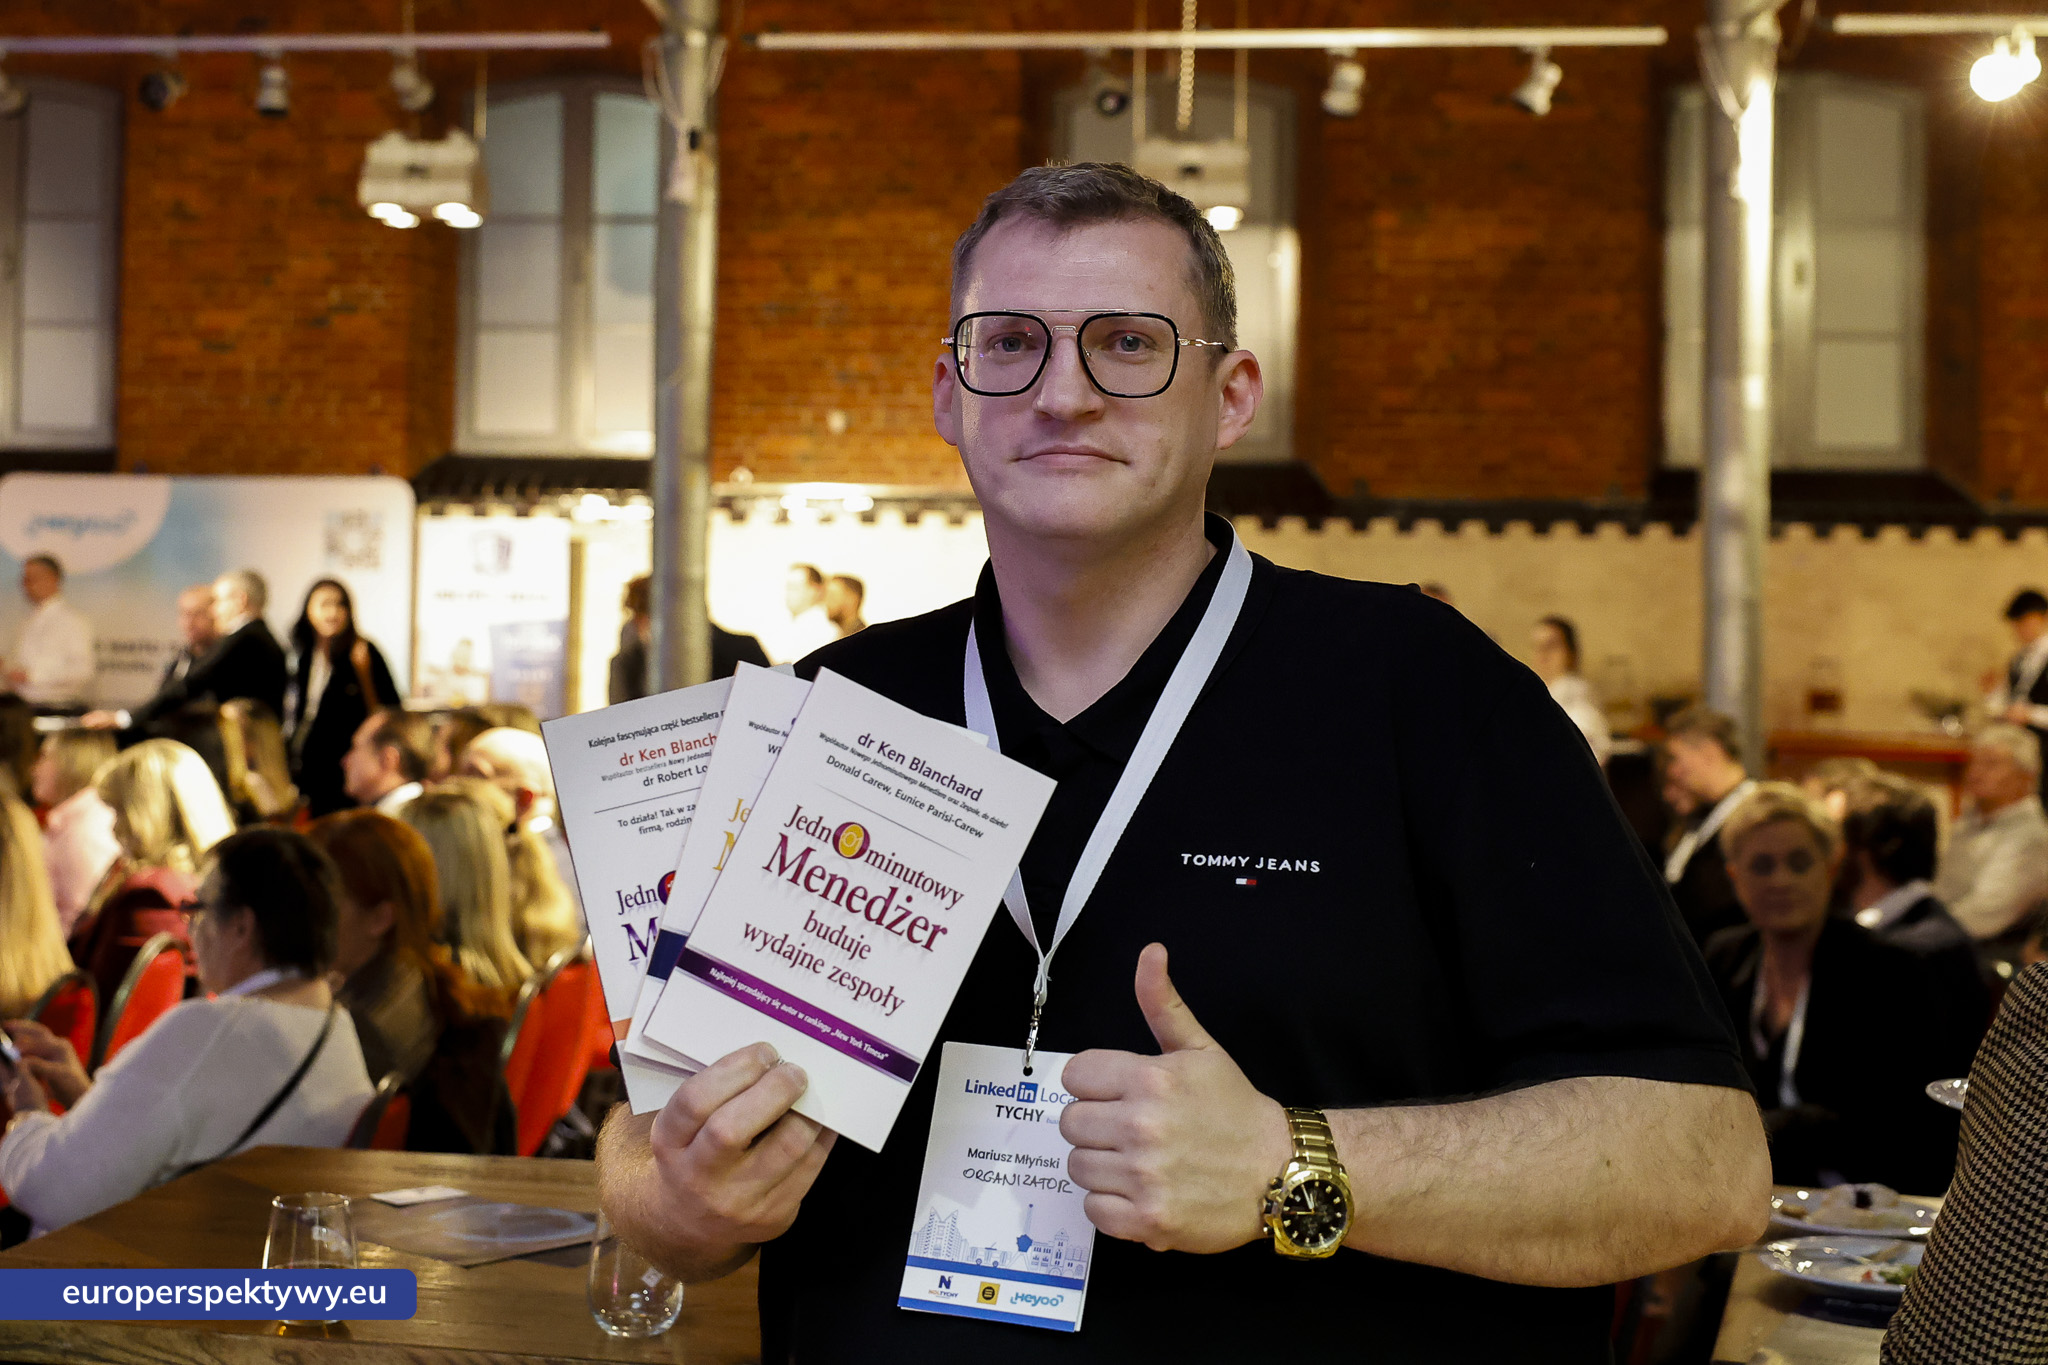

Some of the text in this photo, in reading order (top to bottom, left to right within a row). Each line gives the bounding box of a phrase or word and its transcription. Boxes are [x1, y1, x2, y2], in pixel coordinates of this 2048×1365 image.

[588, 736, 616, 748] Kolejna
[616, 725, 659, 741] fascynująca
[680, 711, 720, 726] bestsellera
[620, 752, 634, 767] dr
[638, 747, 666, 762] Ken
[858, 732, 983, 802] dr Ken Blanchard
[643, 776, 654, 787] dr
[658, 767, 693, 784] Robert
[826, 754, 984, 838] Donald Carew, Eunice Parisi-Carew
[617, 819, 628, 828] To
[630, 810, 658, 825] działa!
[660, 808, 676, 818] Tak
[677, 806, 685, 814] w
[1181, 853, 1320, 873] TOMMY JEANS
[762, 832, 948, 953] Menedżer
[803, 910, 872, 960] buduje
[743, 922, 906, 1017] wydajne zespoły
[850, 1036, 863, 1048] York
[996, 1104, 1044, 1122] TYCHY
[967, 1147, 1060, 1169] Mariusz Młyński
